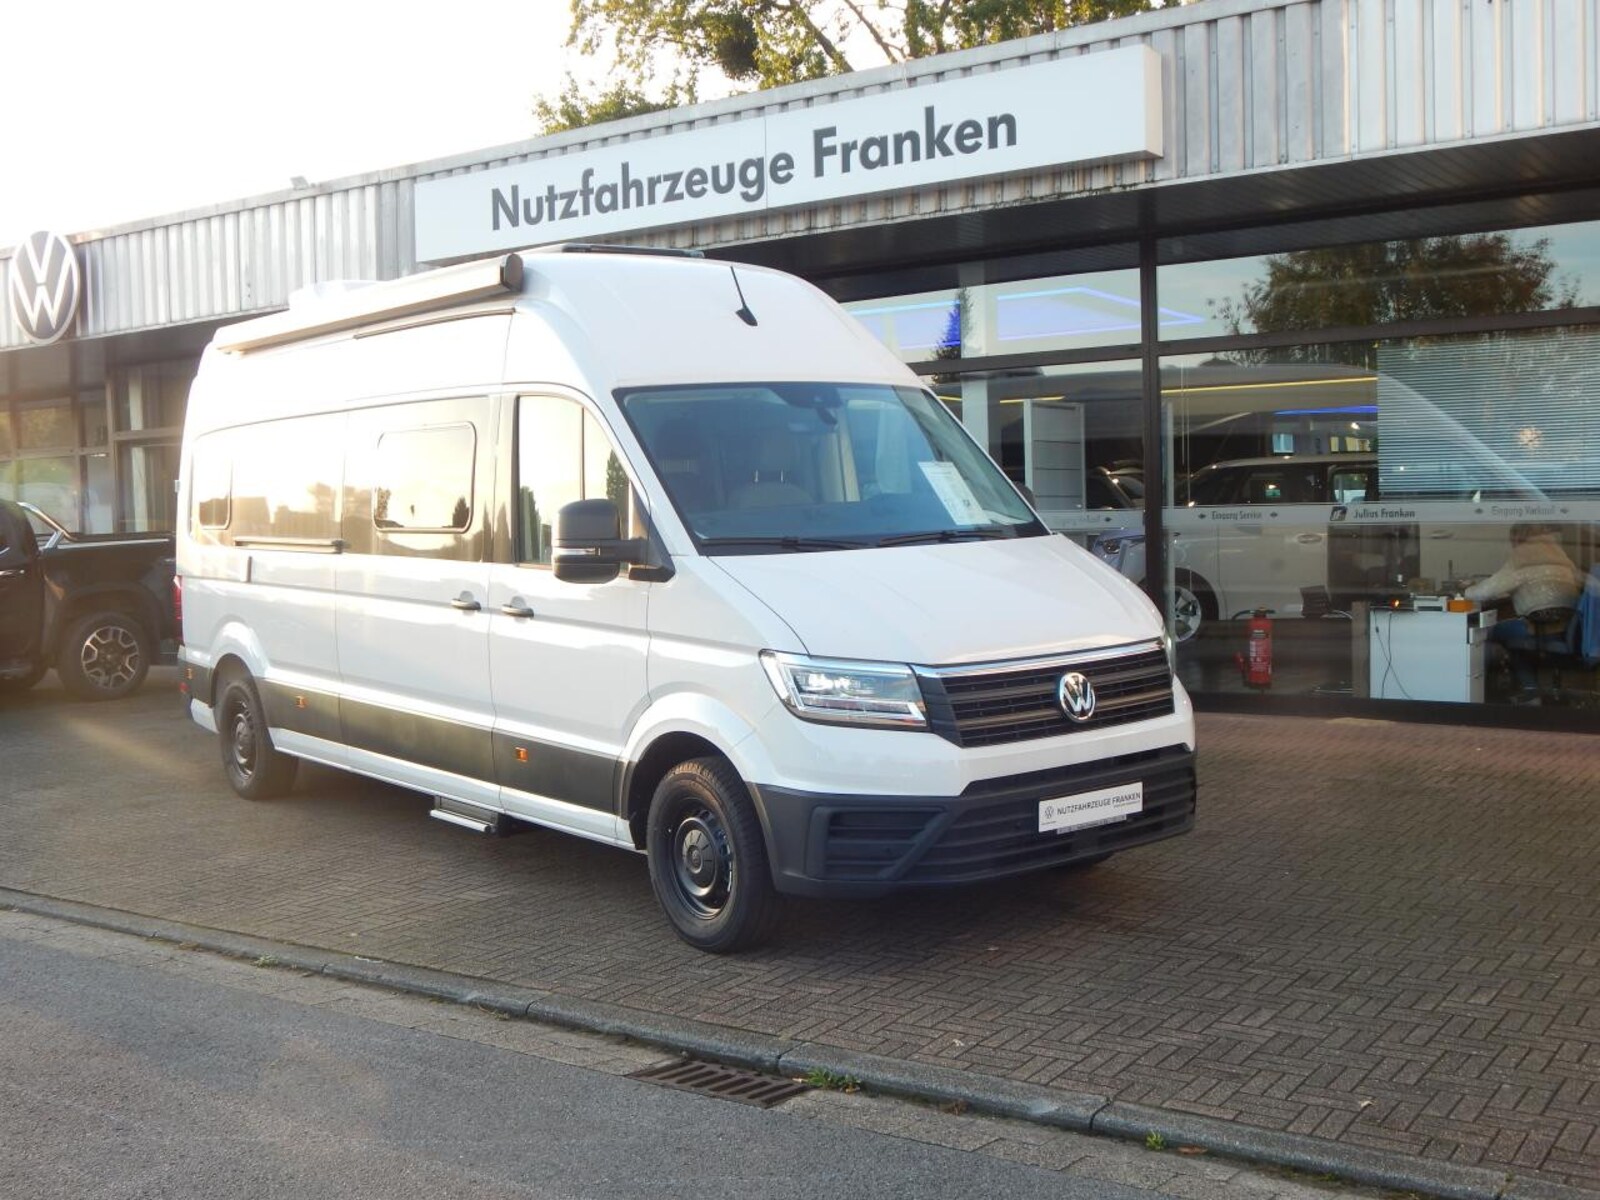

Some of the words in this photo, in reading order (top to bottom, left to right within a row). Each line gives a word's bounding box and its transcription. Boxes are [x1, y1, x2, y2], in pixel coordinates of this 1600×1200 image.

[491, 152, 795, 230] Nutzfahrzeuge
[813, 106, 1017, 178] Franken
[1353, 509, 1378, 519] Julius
[1380, 508, 1415, 518] Franken
[1057, 798, 1111, 815] NUTZFAHRZEUGE
[1112, 792, 1141, 805] FRANKEN
